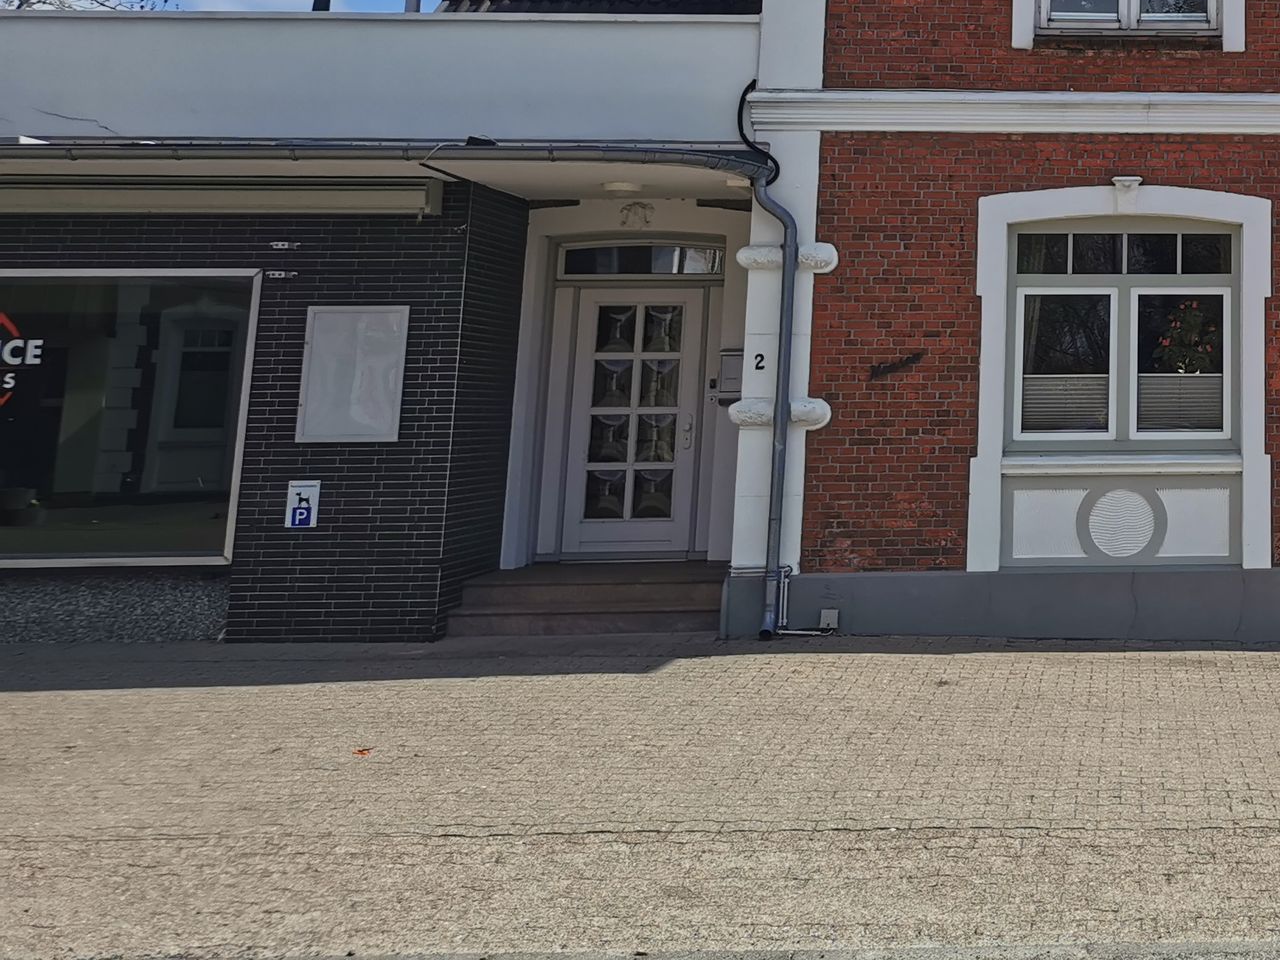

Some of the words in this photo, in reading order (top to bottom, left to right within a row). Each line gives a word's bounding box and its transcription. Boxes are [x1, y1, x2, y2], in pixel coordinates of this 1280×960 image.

[0, 339, 44, 365] CE
[754, 353, 765, 370] 2
[295, 509, 308, 525] P
